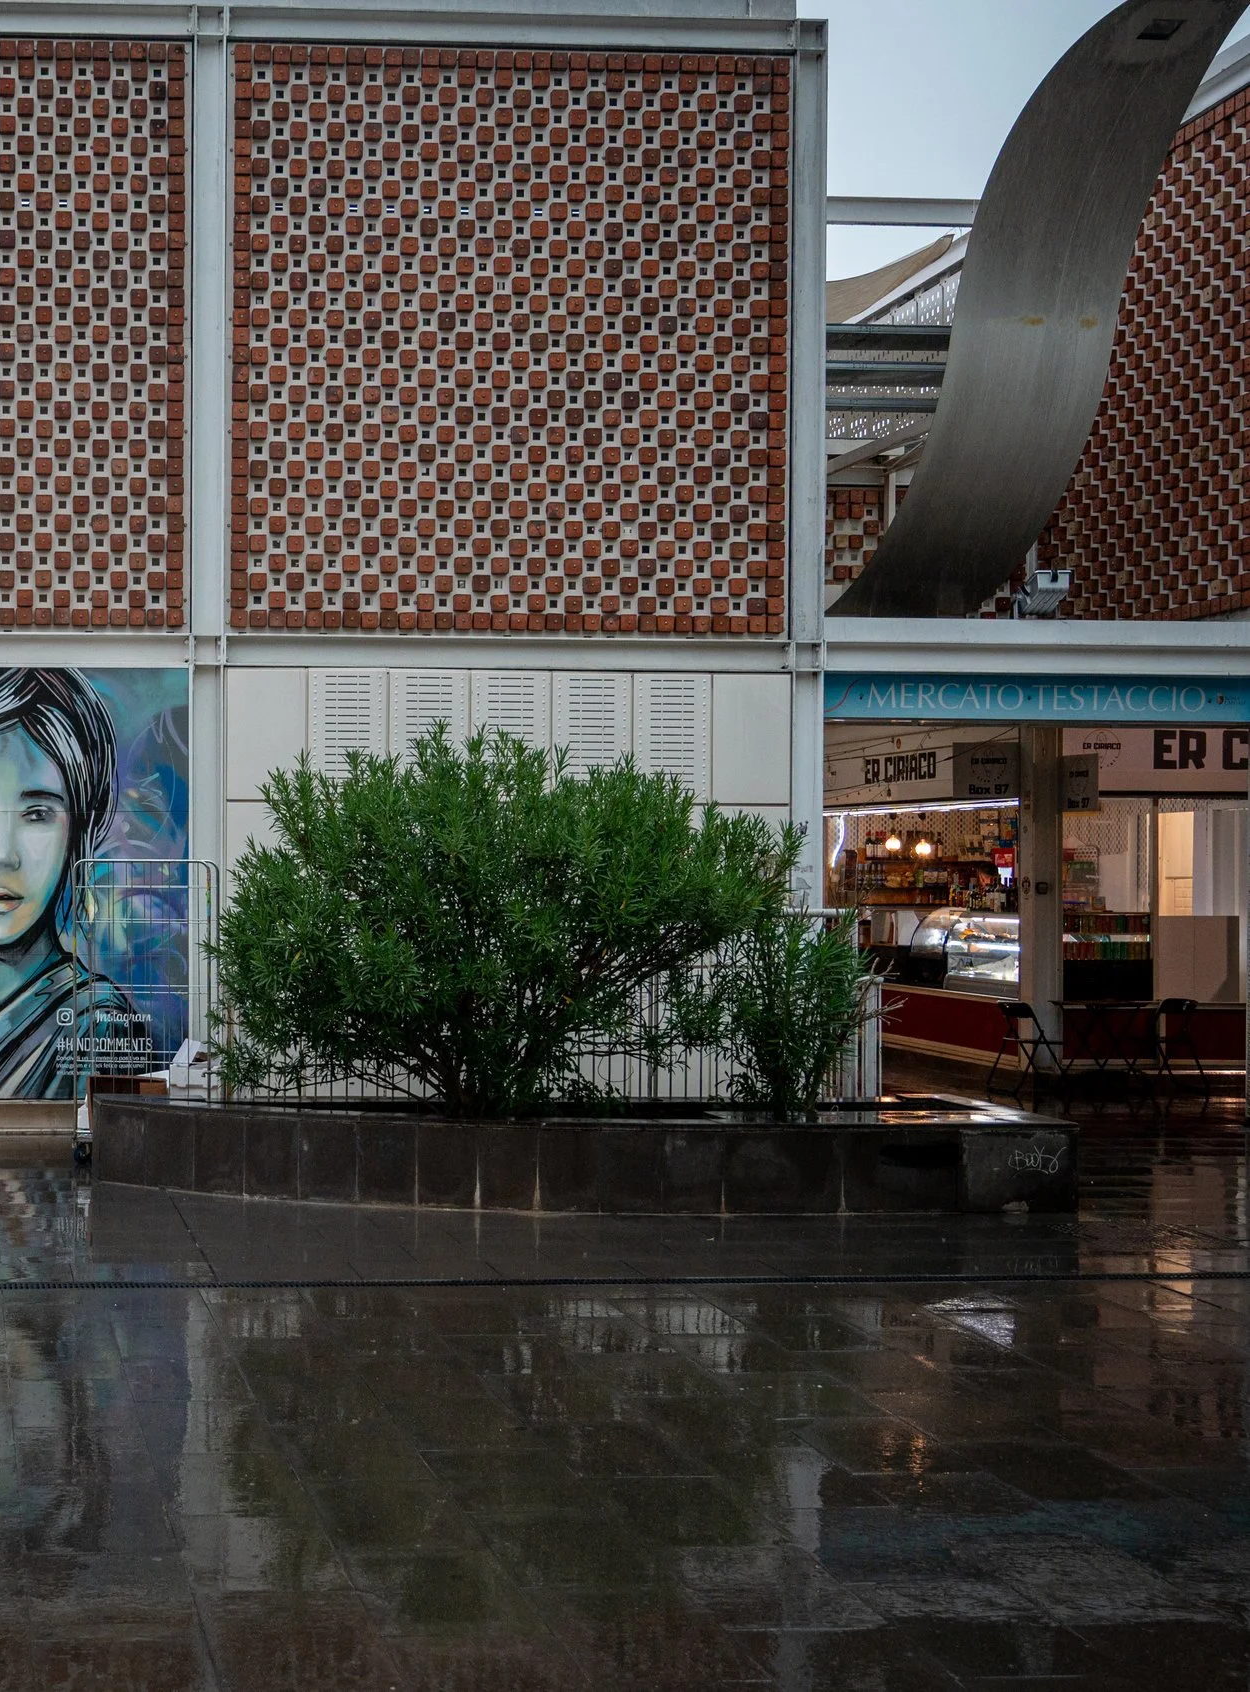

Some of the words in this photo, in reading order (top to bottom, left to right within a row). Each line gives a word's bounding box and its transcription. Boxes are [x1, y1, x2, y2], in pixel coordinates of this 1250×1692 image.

[867, 682, 1024, 711] MERCATO
[1032, 685, 1206, 712] TESTACCIO
[1154, 730, 1207, 770] ER
[864, 757, 880, 785] ER
[884, 751, 937, 784] CIRIACO
[969, 784, 991, 795] Box
[995, 784, 1009, 794] 97
[95, 1010, 151, 1027] Instagram
